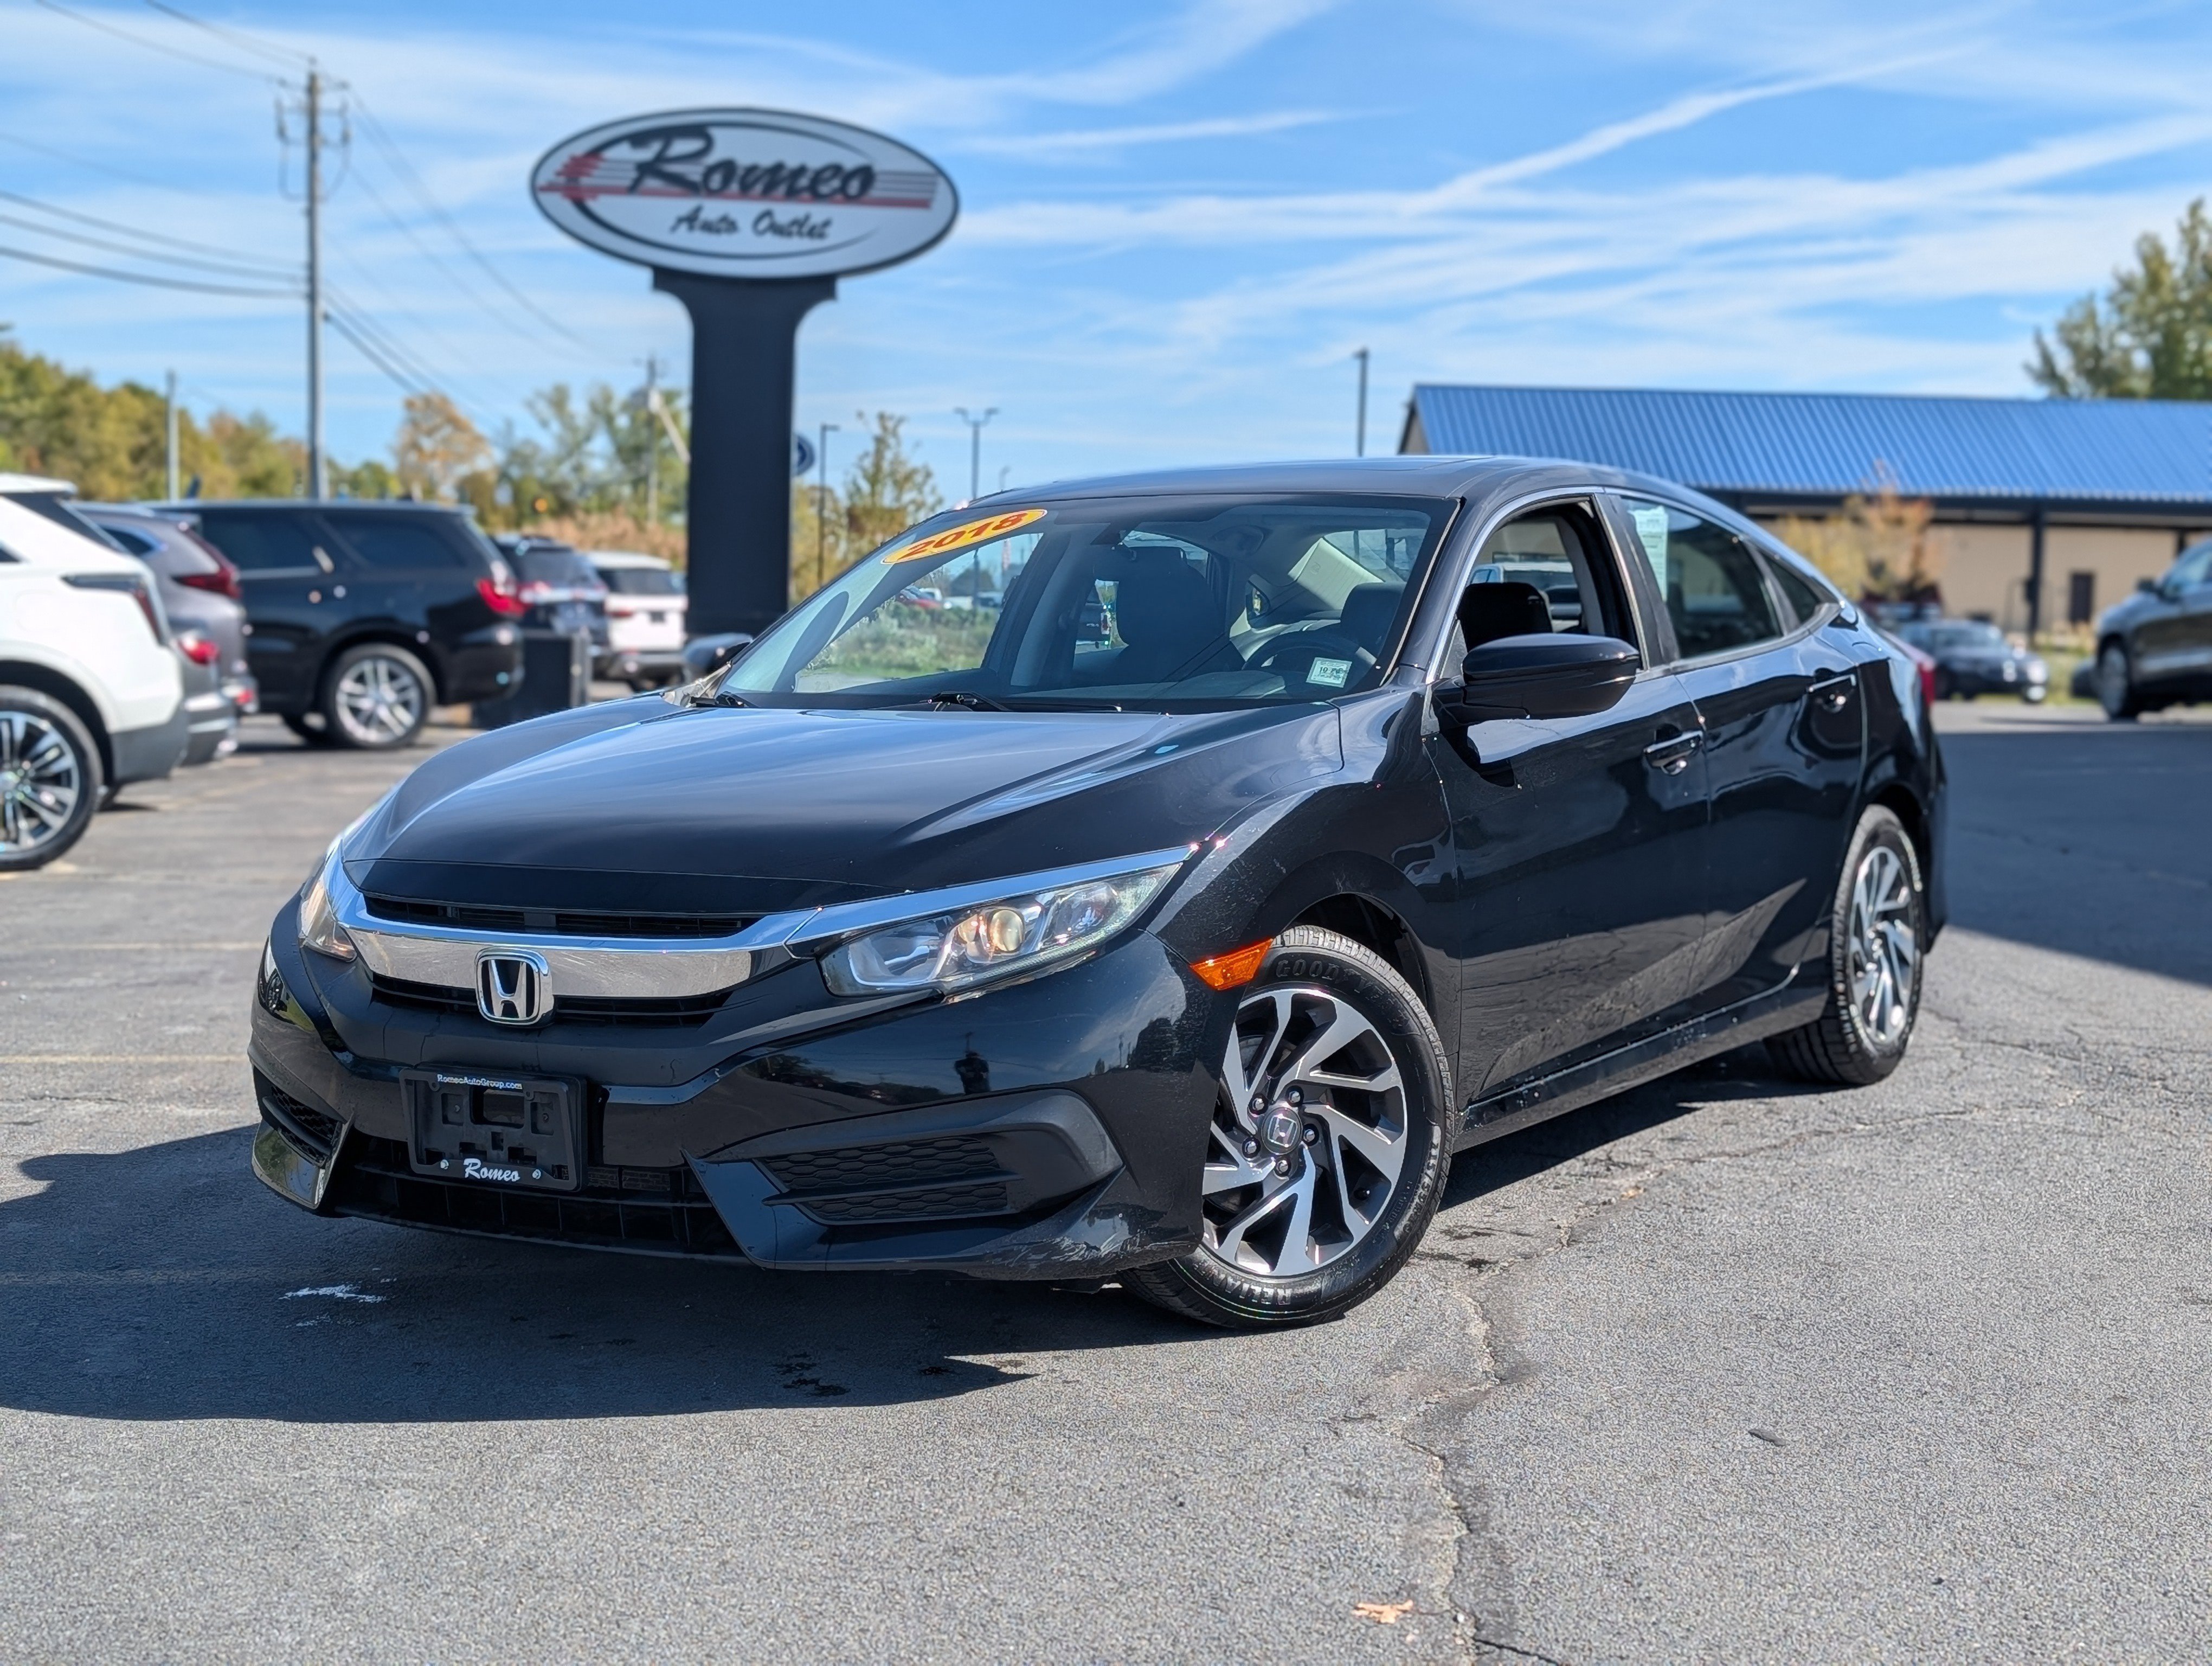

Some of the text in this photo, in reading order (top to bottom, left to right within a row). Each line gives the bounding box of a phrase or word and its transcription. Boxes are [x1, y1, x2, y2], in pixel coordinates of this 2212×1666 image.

[627, 125, 876, 200] Romeo
[670, 204, 832, 240] Auto Outlet
[897, 512, 1028, 561] 2018
[437, 1074, 522, 1090] RomeoAutoGroup.com
[463, 1158, 520, 1182] Romeo
